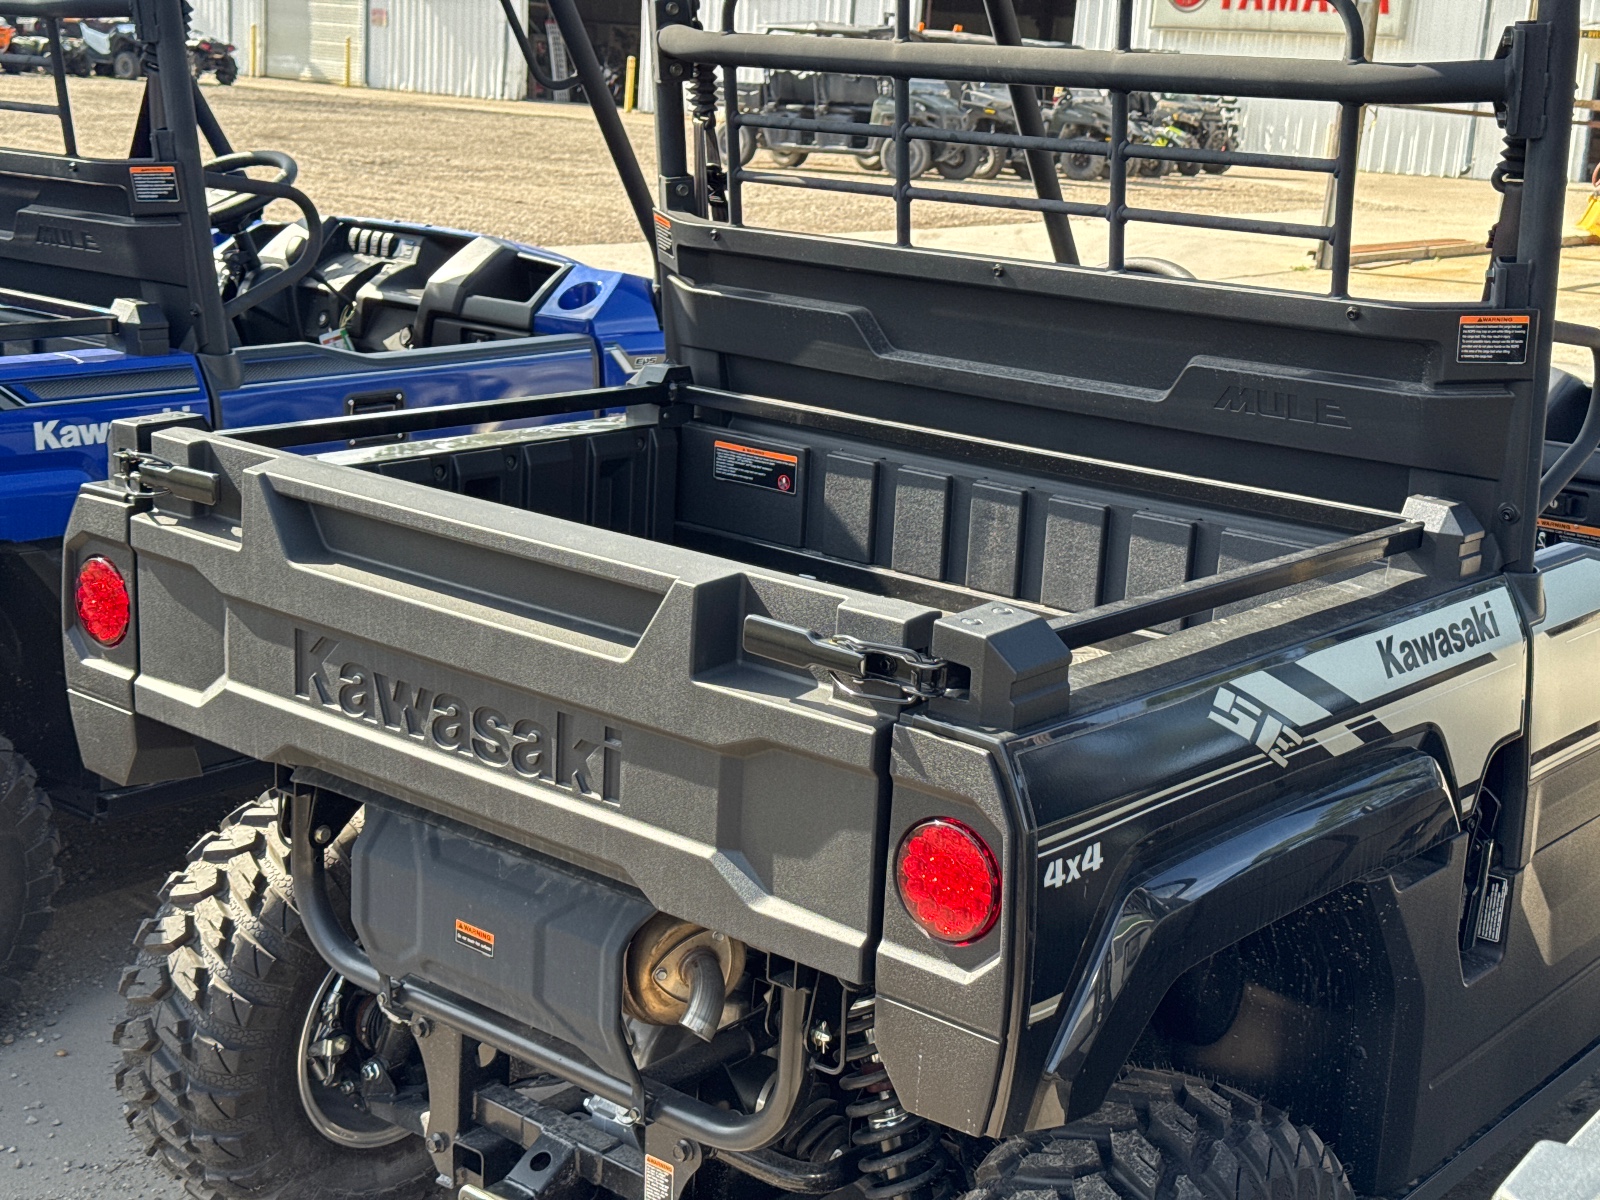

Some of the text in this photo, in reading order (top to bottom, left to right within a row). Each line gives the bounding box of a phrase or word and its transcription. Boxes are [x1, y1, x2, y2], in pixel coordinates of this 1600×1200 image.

[36, 224, 102, 253] MULE
[1213, 385, 1352, 429] MULE
[1541, 521, 1571, 530] WARNING
[1376, 600, 1501, 679] Kawasaki
[294, 628, 622, 807] Kawasaki
[1043, 841, 1104, 888] 4x4
[463, 924, 492, 941] WARNING
